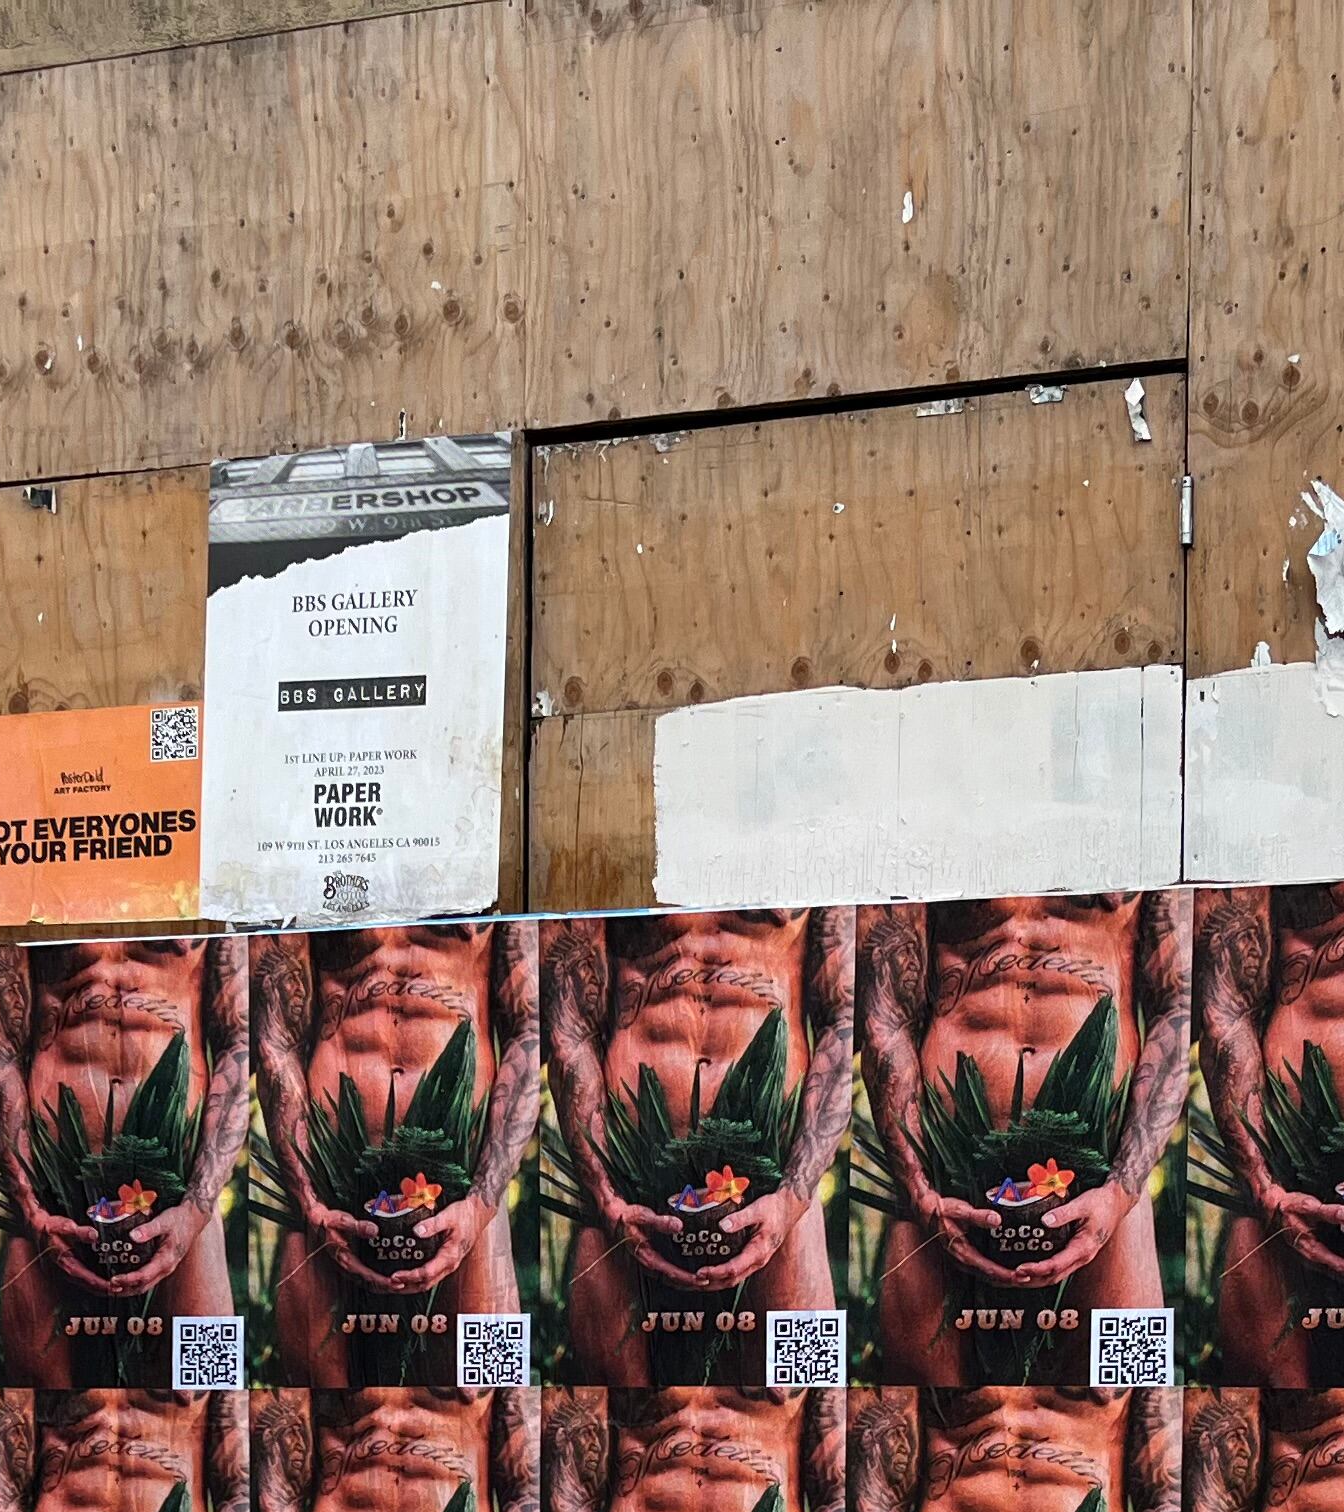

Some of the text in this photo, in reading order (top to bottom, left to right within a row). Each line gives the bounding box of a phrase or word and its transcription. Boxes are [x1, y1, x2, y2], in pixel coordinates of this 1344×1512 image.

[292, 589, 418, 613] BBS GALLERY
[308, 616, 398, 637] OPENING
[280, 683, 425, 705] BBS GALLERY
[302, 752, 327, 764] LINE
[348, 751, 383, 762] PAPER
[384, 749, 418, 761] WORK
[313, 767, 345, 777] APRIL
[363, 765, 385, 776] 2023
[54, 784, 112, 795] ART FACTORY
[313, 782, 381, 804] PAPER
[33, 809, 197, 840] EVERYONES
[73, 834, 172, 862] FRIEND
[257, 841, 273, 851] 109
[274, 841, 286, 850] W
[324, 839, 347, 850] LOS
[347, 838, 394, 849] ANGELES
[396, 838, 411, 848] CA
[412, 837, 441, 848] 90015
[318, 853, 377, 864] 213 265 7645
[65, 1316, 163, 1335] JUN 08
[341, 1314, 448, 1333] JUN 08
[641, 1311, 756, 1332] JUN 08
[955, 1309, 1079, 1330] JUN 08
